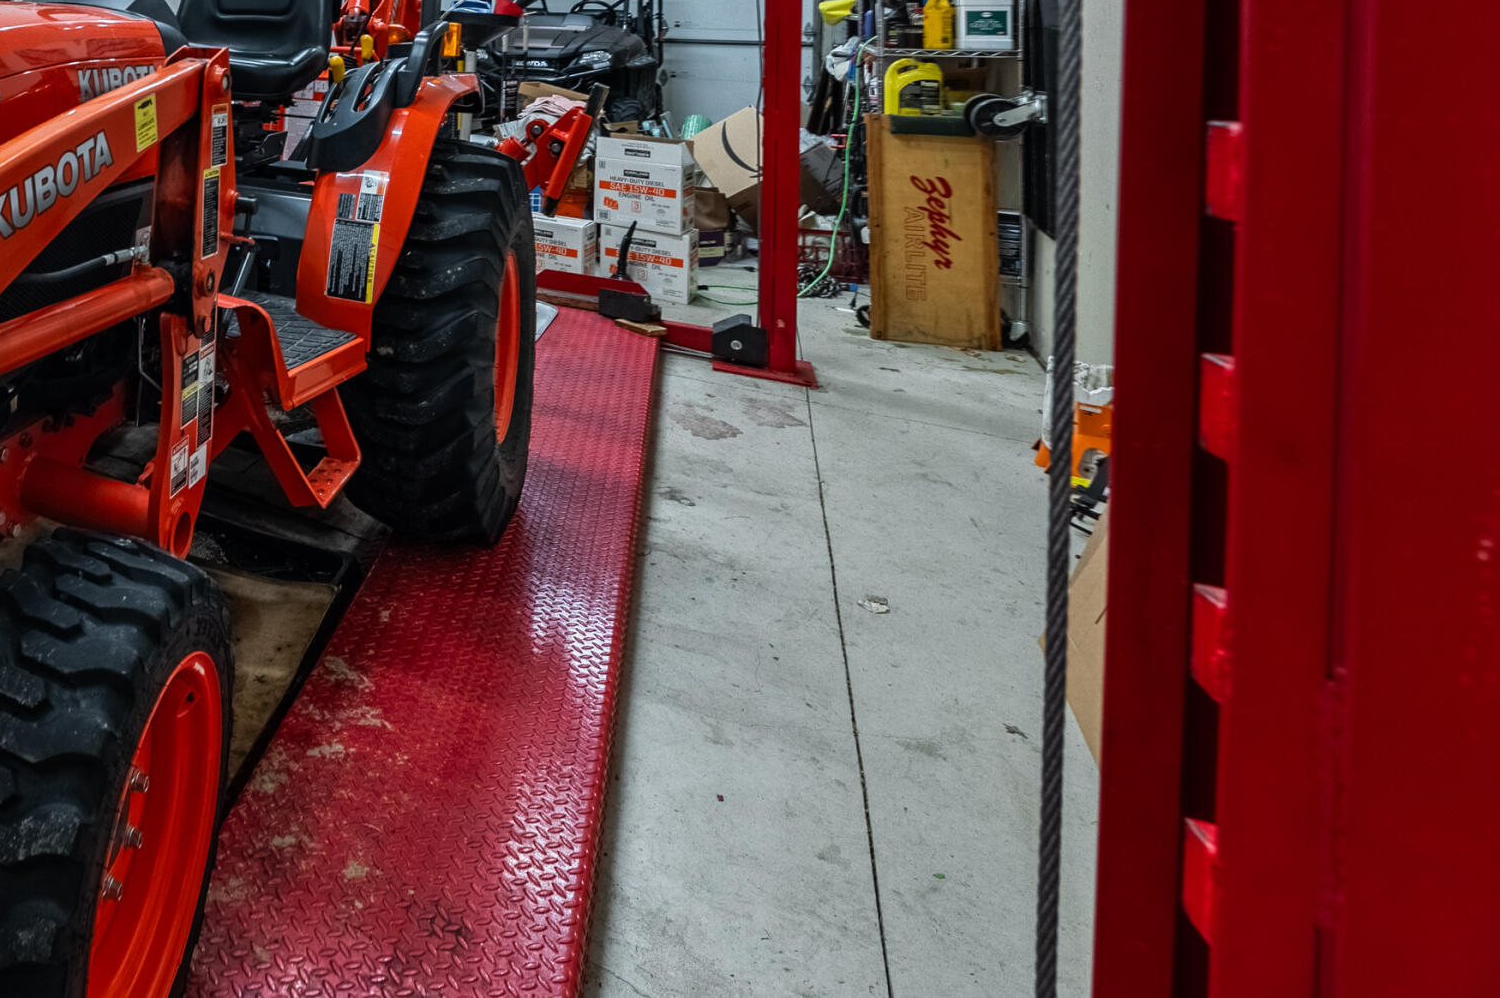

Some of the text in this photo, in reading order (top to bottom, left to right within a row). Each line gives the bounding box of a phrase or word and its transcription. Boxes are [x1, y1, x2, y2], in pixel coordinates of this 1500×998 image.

[610, 182, 665, 196] SAE 15W-40
[910, 175, 962, 270] Zephyr
[903, 206, 927, 302] AIRLITE
